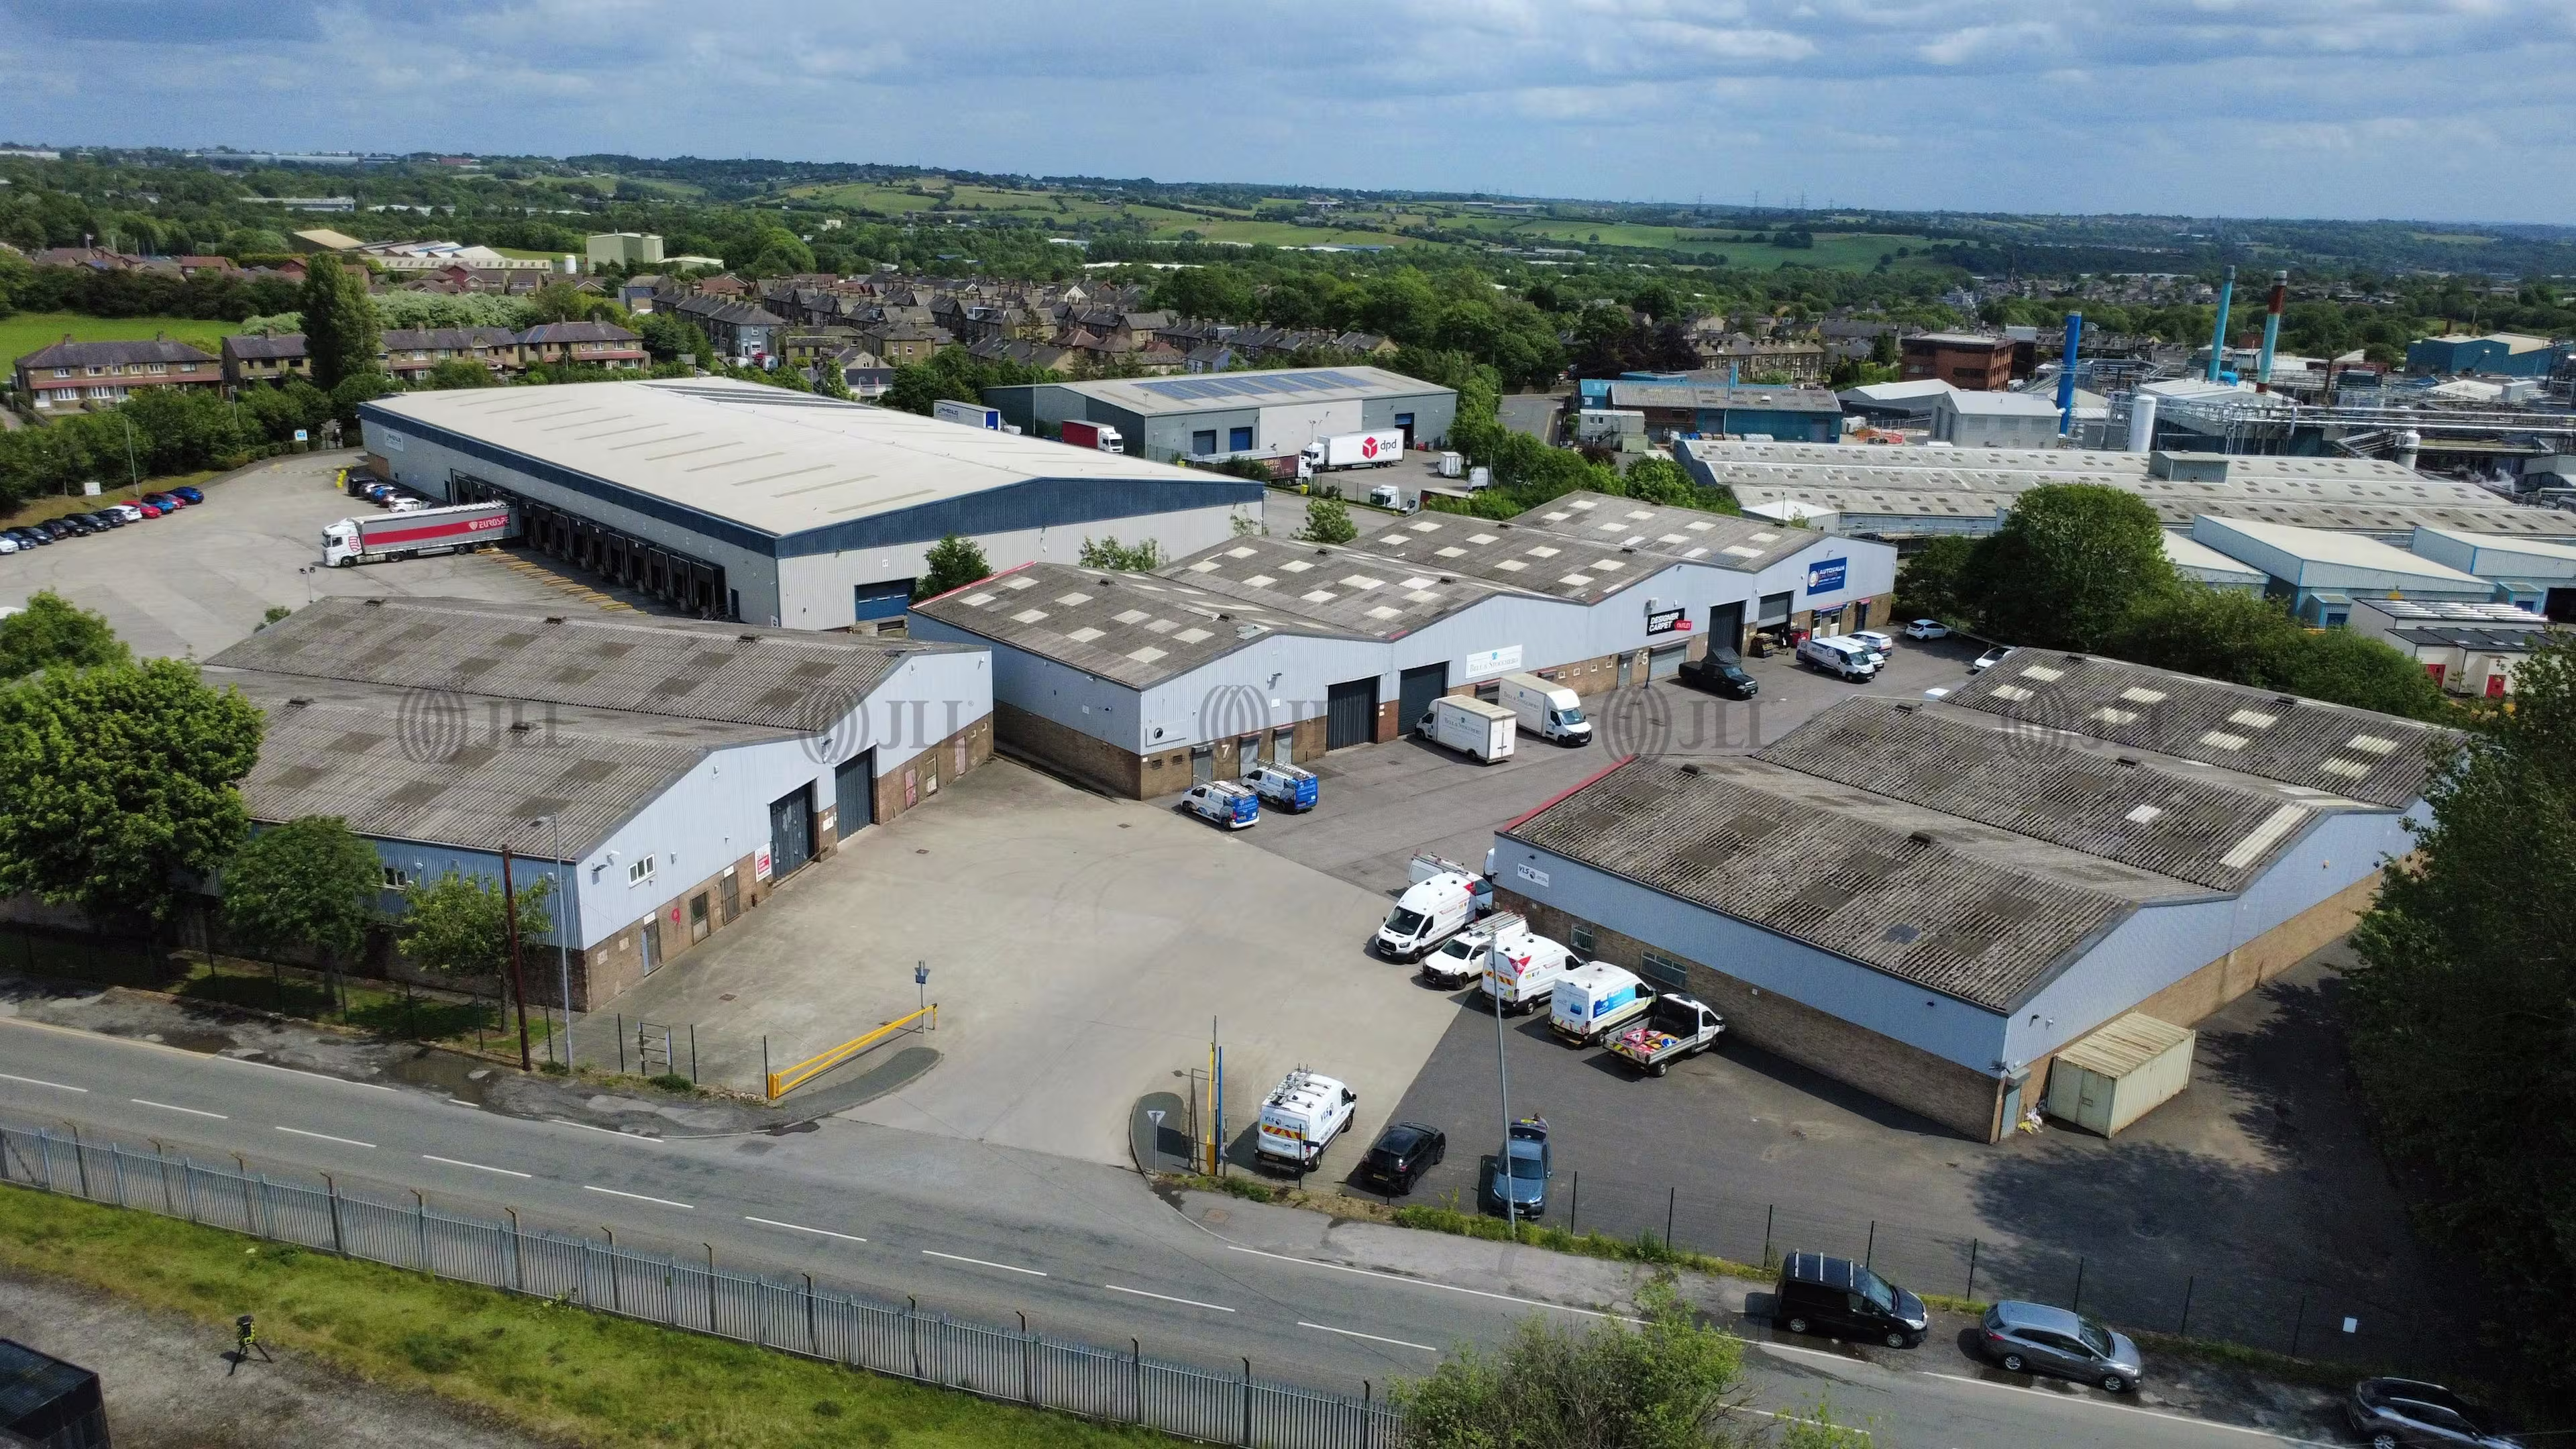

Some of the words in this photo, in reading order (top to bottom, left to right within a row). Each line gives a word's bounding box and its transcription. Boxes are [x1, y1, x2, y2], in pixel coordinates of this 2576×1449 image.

[1380, 439, 1397, 452] dpd
[1651, 612, 1679, 625] DESIGNER
[1649, 621, 1672, 632] CARPET
[1642, 652, 1648, 665] 5
[1221, 744, 1231, 759] 7
[1519, 865, 1529, 874] VLS
